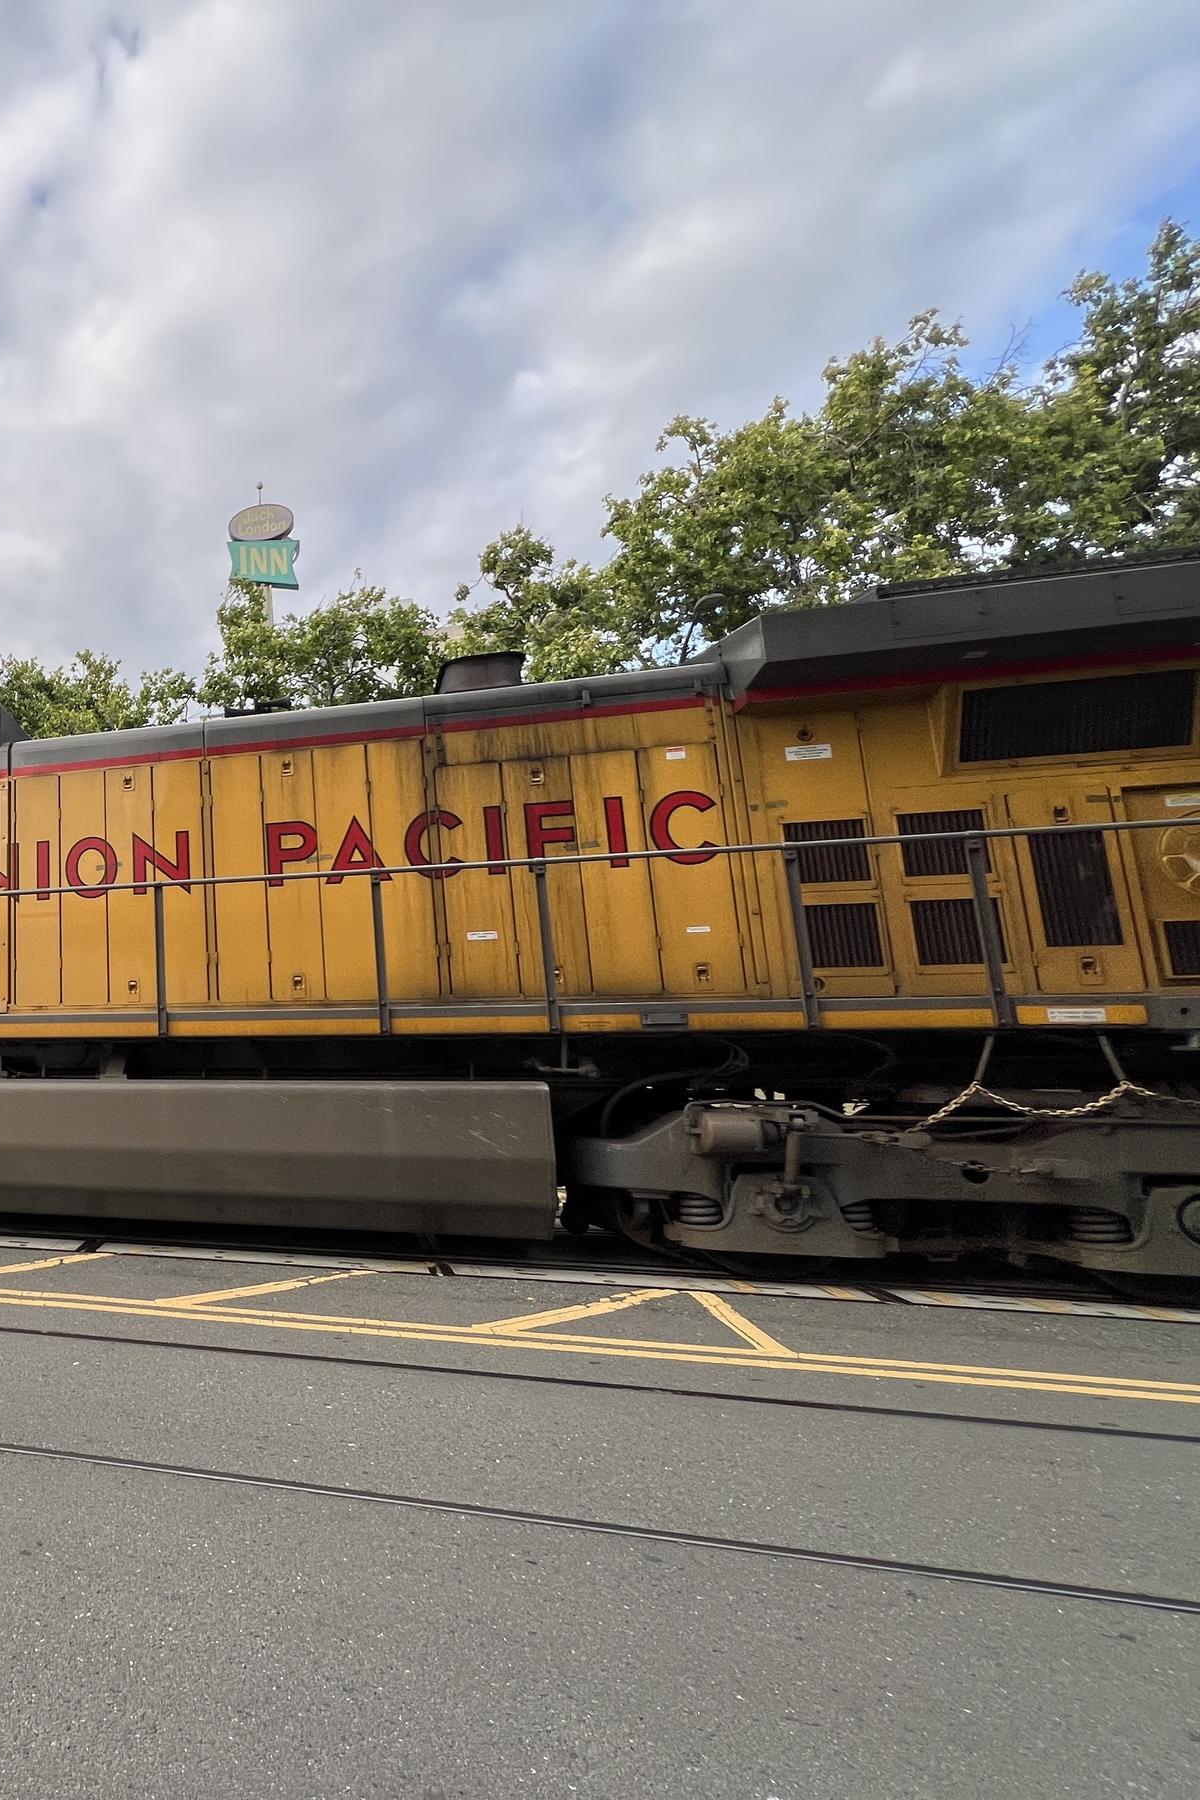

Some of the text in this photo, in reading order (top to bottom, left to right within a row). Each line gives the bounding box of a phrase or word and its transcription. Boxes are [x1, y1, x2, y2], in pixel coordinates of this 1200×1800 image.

[238, 520, 286, 536] London
[243, 508, 276, 524] Jack
[239, 544, 288, 577] INN
[265, 789, 717, 888] PACIFIC
